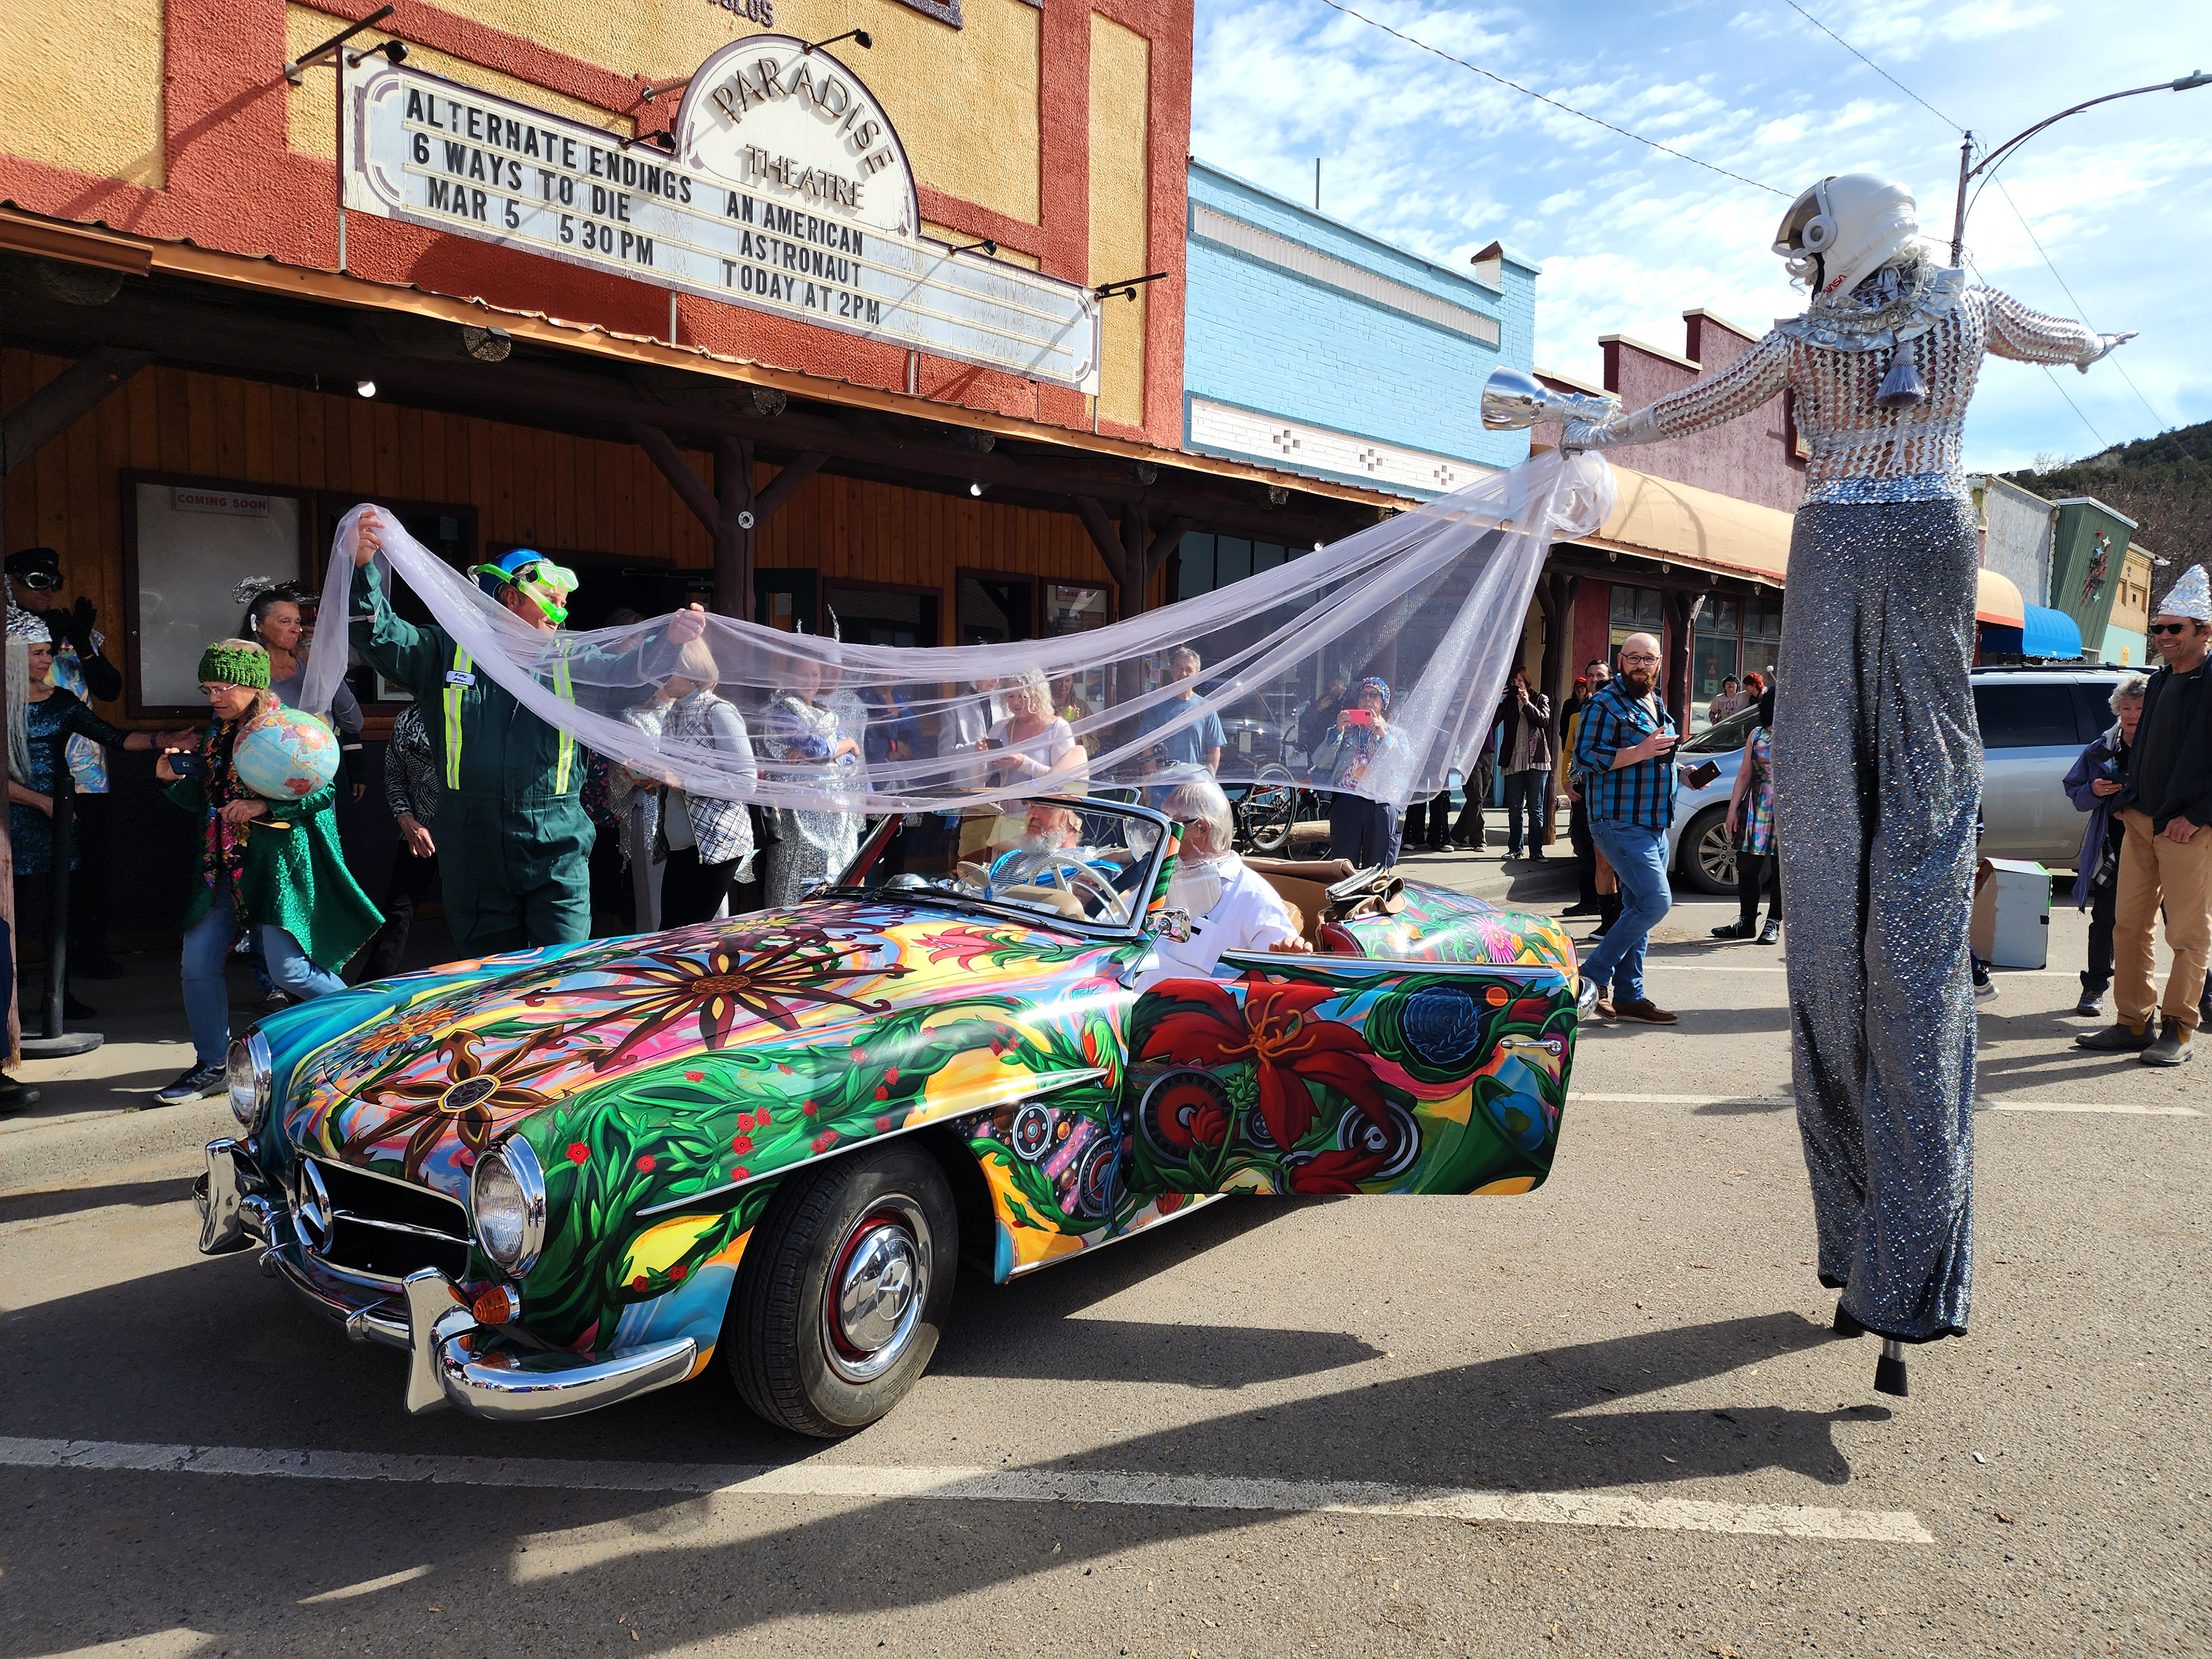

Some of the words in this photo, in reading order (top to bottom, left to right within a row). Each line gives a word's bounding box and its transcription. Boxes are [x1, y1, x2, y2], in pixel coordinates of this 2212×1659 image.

[406, 89, 577, 169] ALTERNATE
[589, 146, 692, 203] ENDINGS
[713, 56, 896, 175] PARADISE
[413, 132, 430, 165] 6
[445, 140, 522, 191] WAYS
[538, 168, 574, 206] TO
[593, 185, 631, 223] DIE
[429, 176, 487, 222] MAR
[505, 199, 520, 230] 5
[746, 143, 865, 210] THEATRE
[726, 191, 753, 224] AN
[763, 202, 863, 256] AMERICAN
[740, 230, 862, 287] ASTRONAUT
[1823, 274, 1847, 296] NASA
[722, 259, 796, 303] TODAY
[806, 282, 833, 312] AT
[839, 291, 880, 325] 2PM
[178, 494, 226, 507] COMING
[233, 499, 266, 510] SOON
